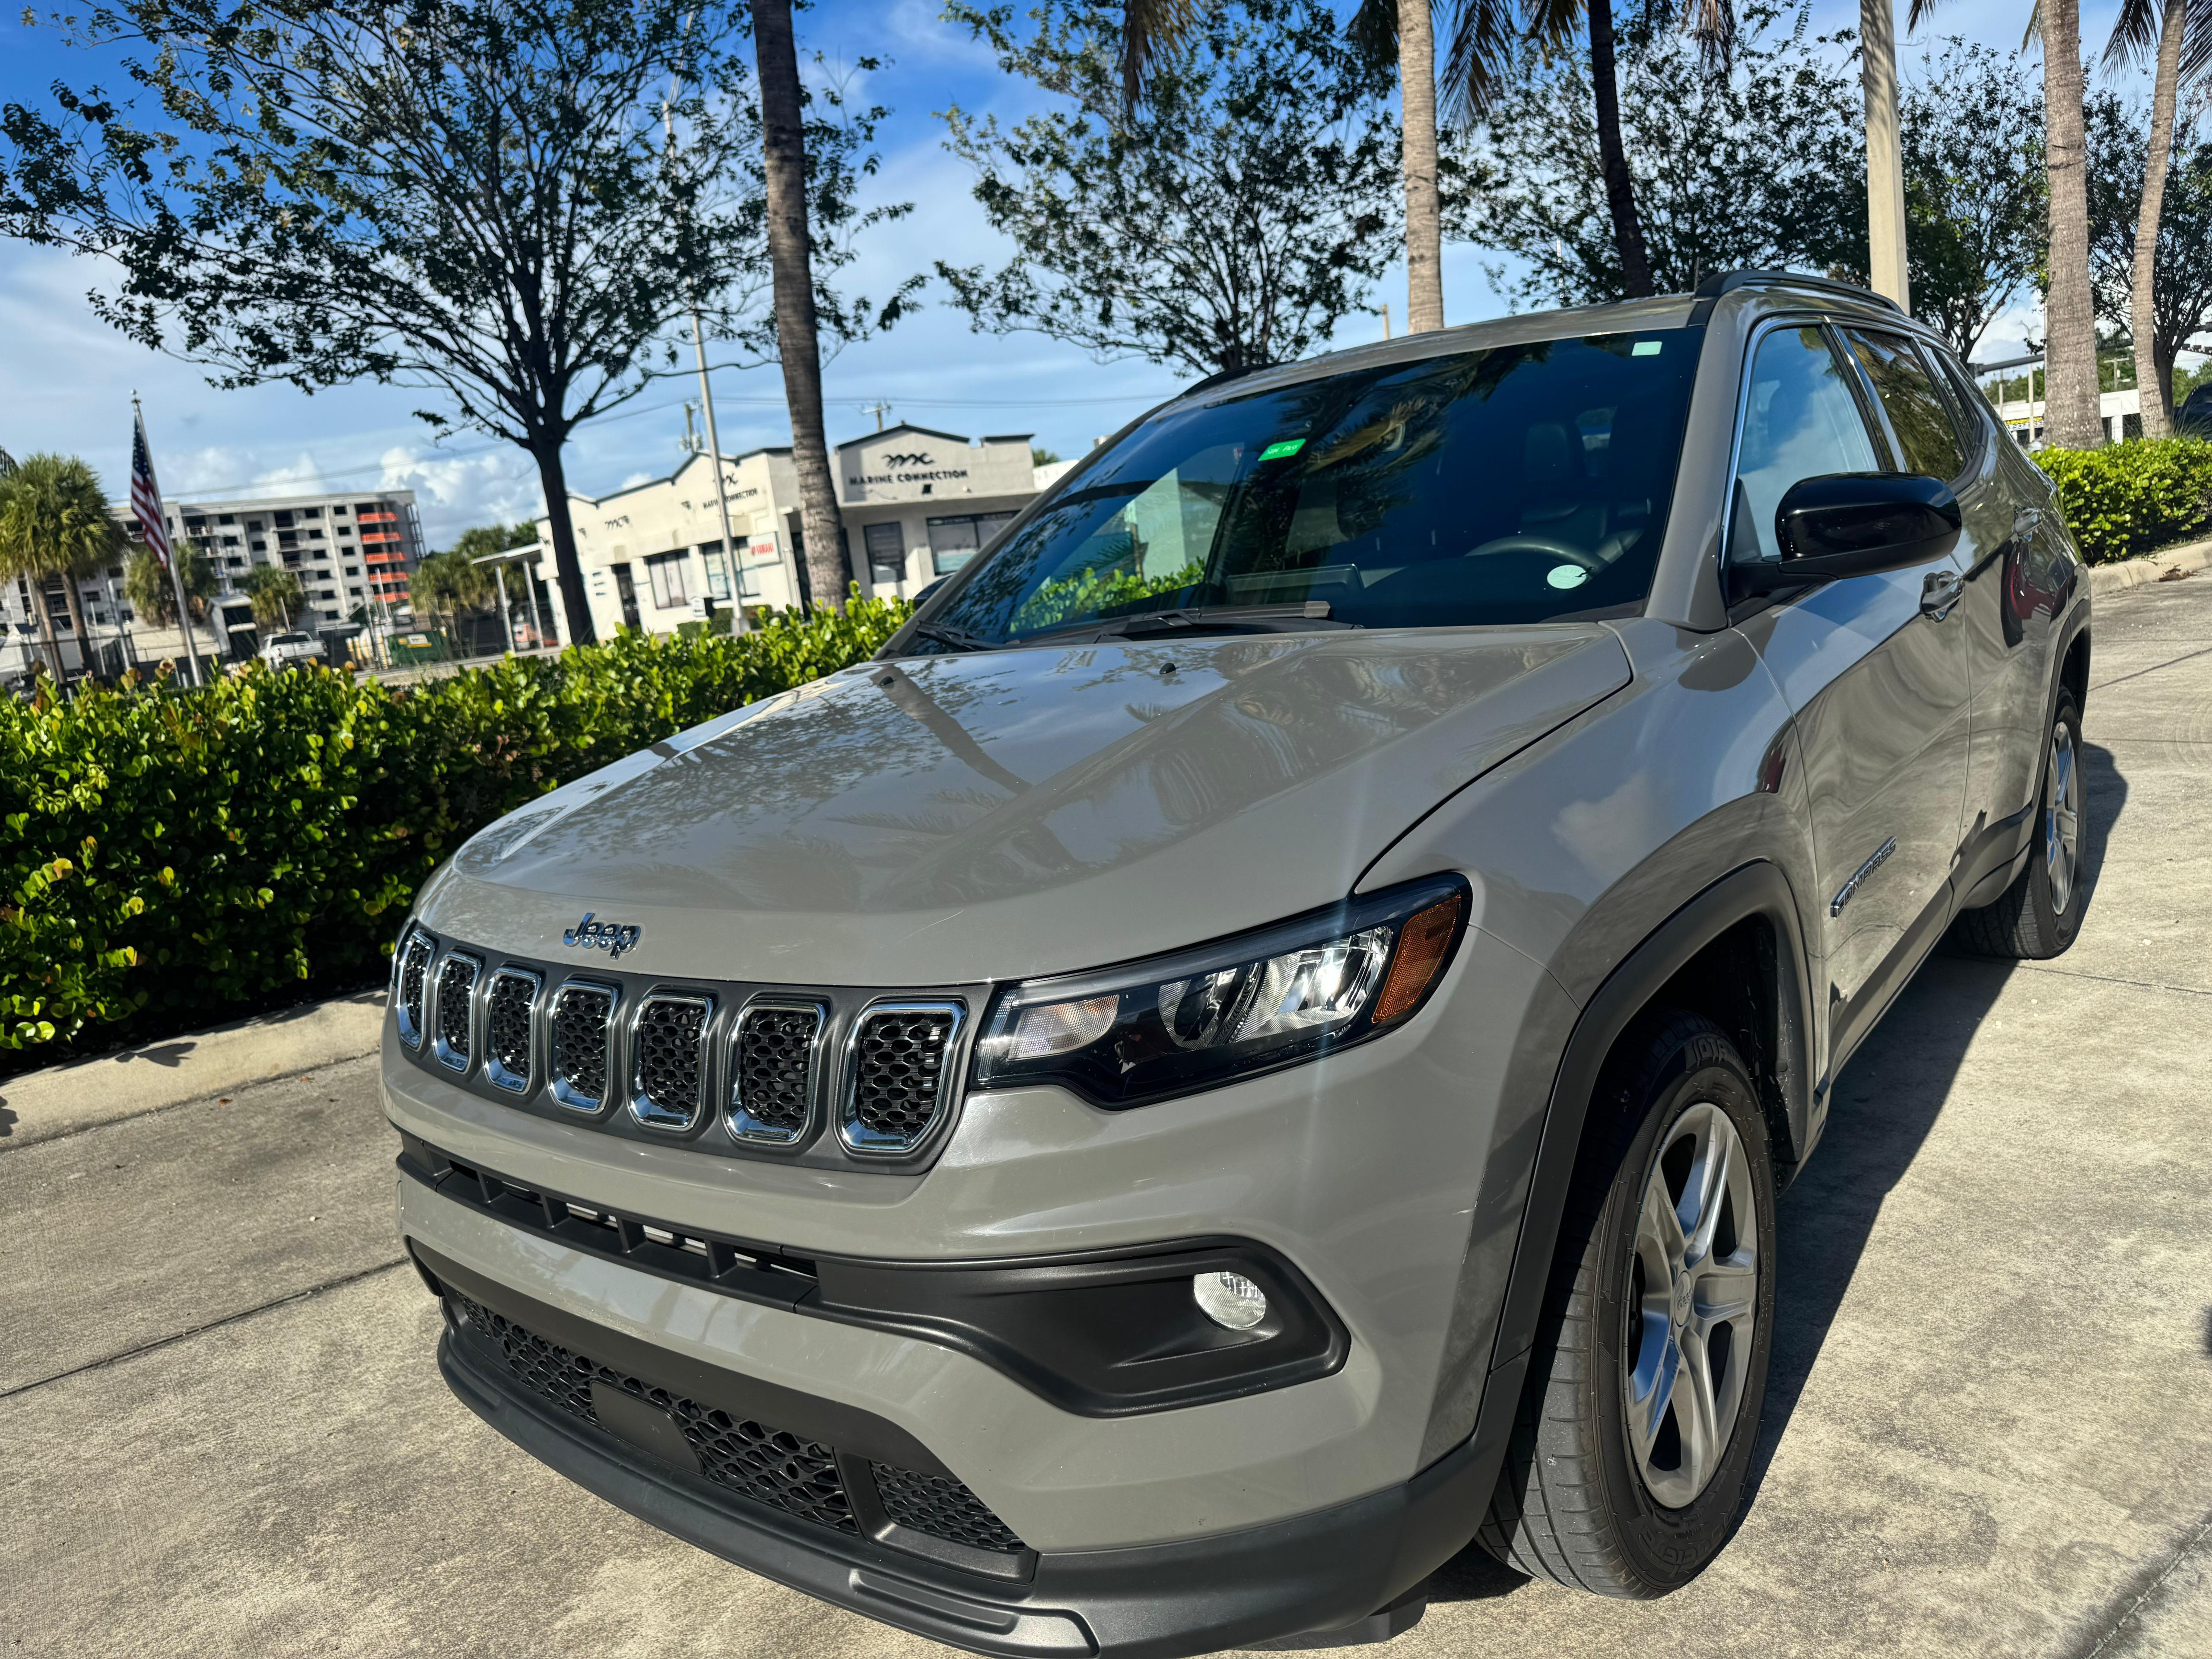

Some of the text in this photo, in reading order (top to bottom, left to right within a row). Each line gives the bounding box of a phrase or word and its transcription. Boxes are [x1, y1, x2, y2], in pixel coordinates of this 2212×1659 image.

[849, 470, 968, 485] MARINE CONNECTION
[1830, 836, 1897, 918] COMPASS
[563, 912, 641, 960] Jeep
